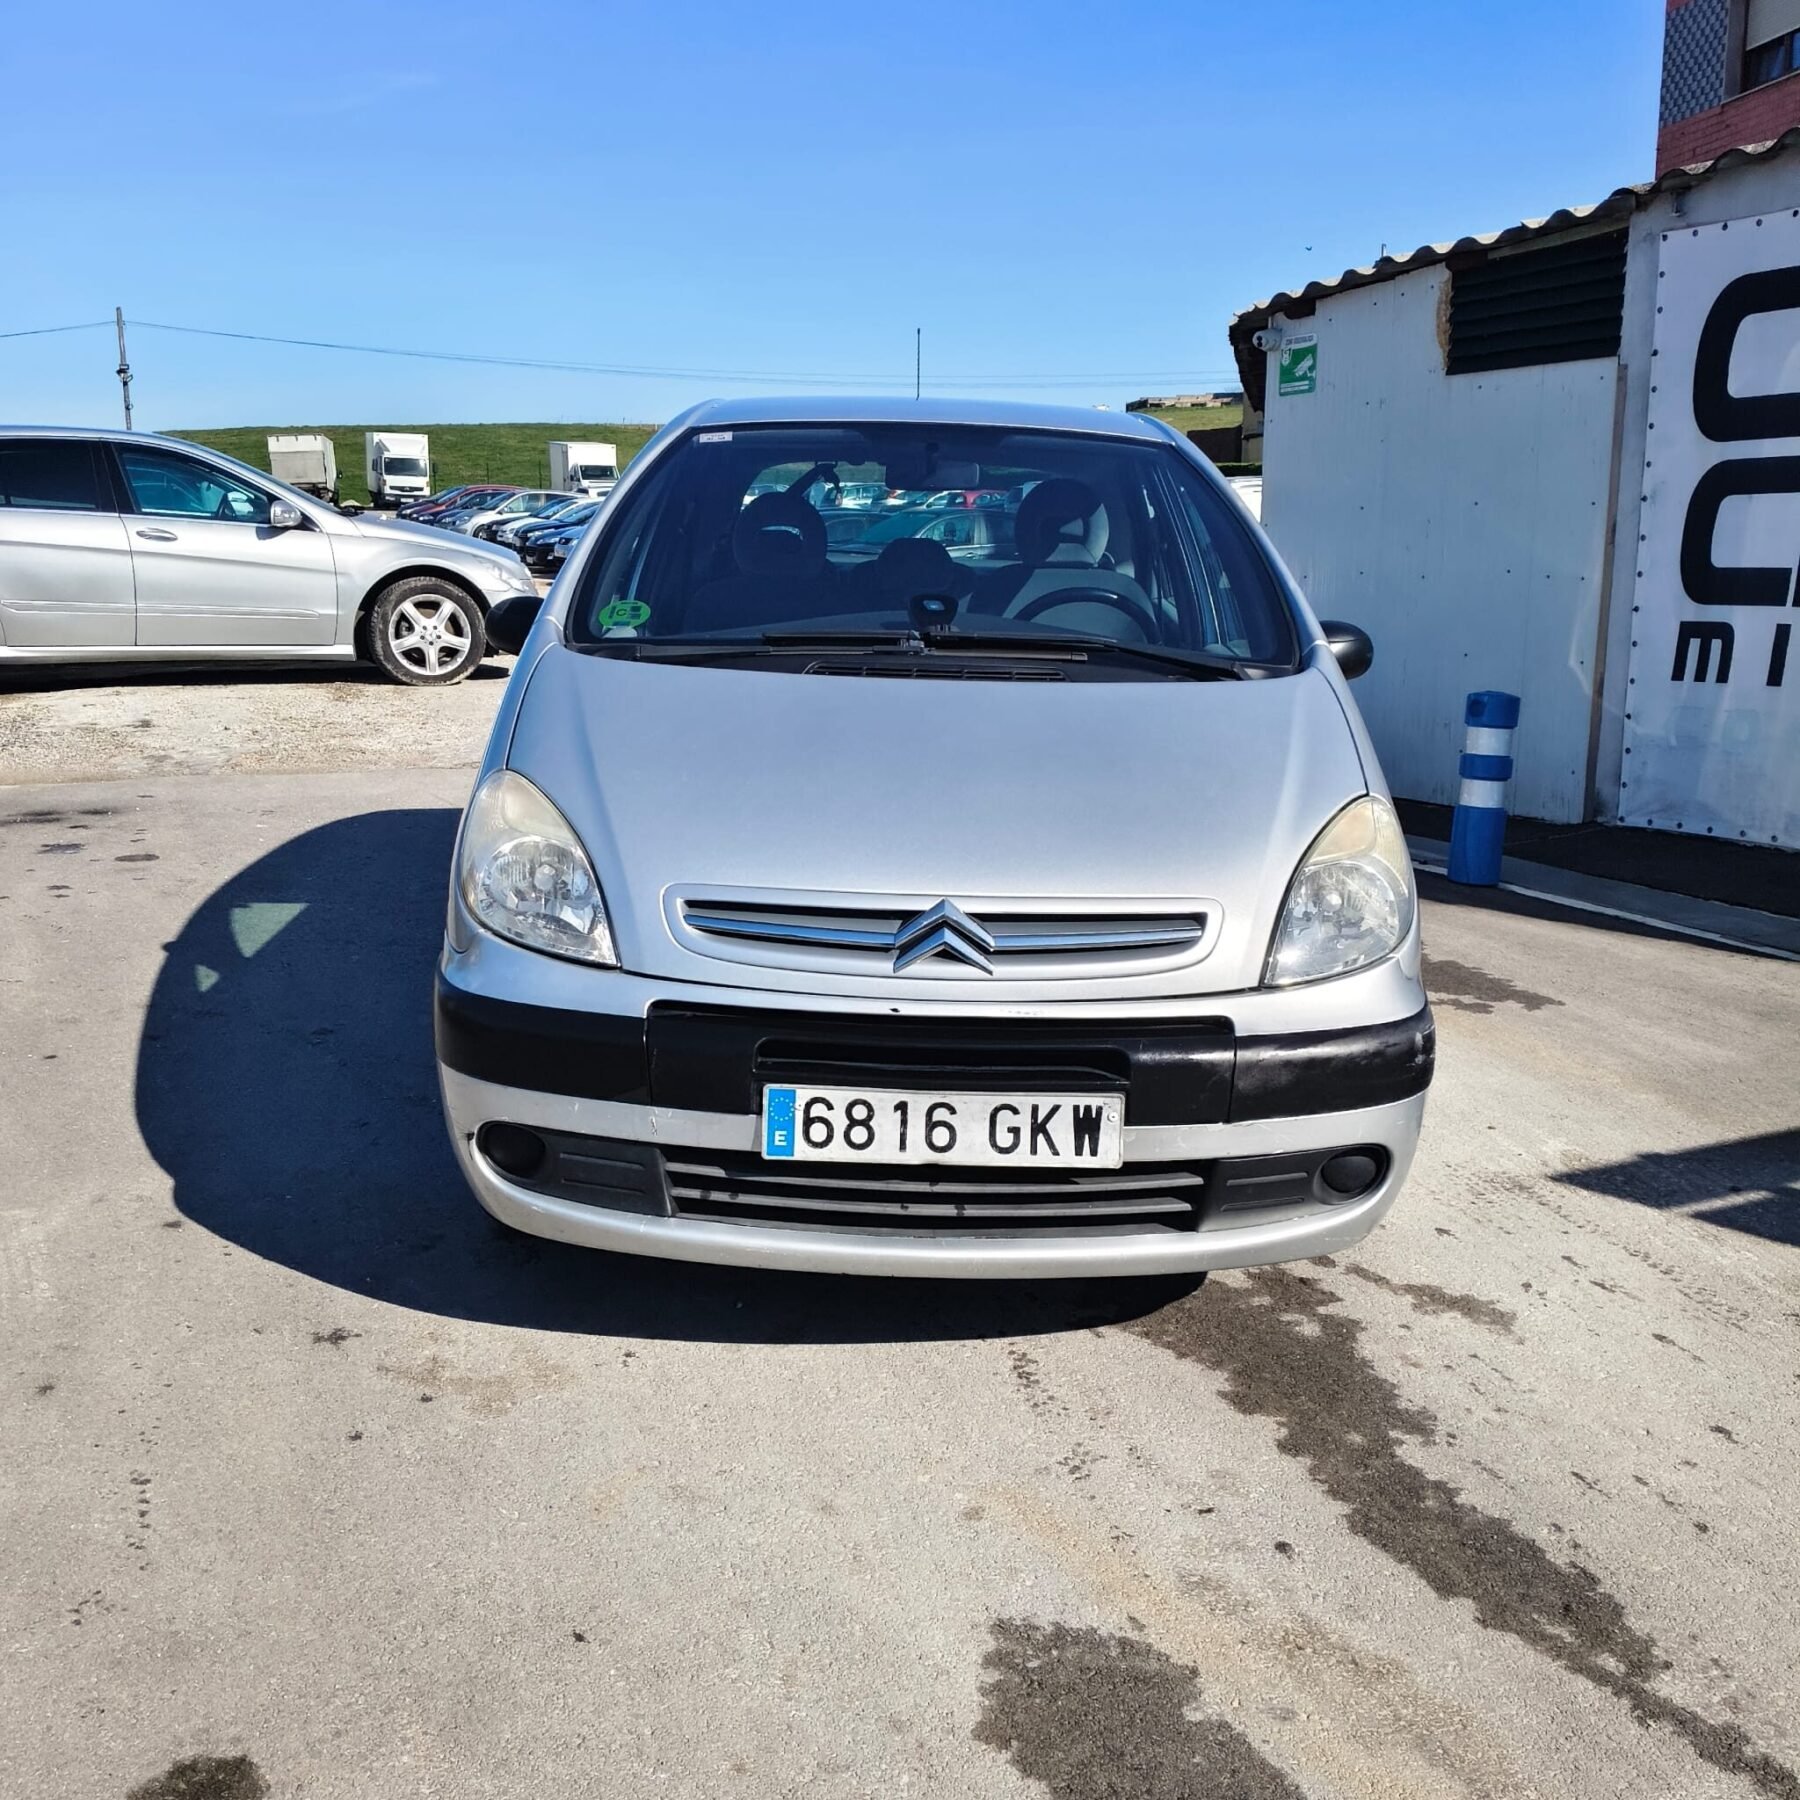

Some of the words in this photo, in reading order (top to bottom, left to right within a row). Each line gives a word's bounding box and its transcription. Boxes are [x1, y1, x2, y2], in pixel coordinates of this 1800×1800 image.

[774, 1130, 787, 1146] E
[802, 1096, 957, 1153] 6816
[988, 1103, 1103, 1157] GKW
